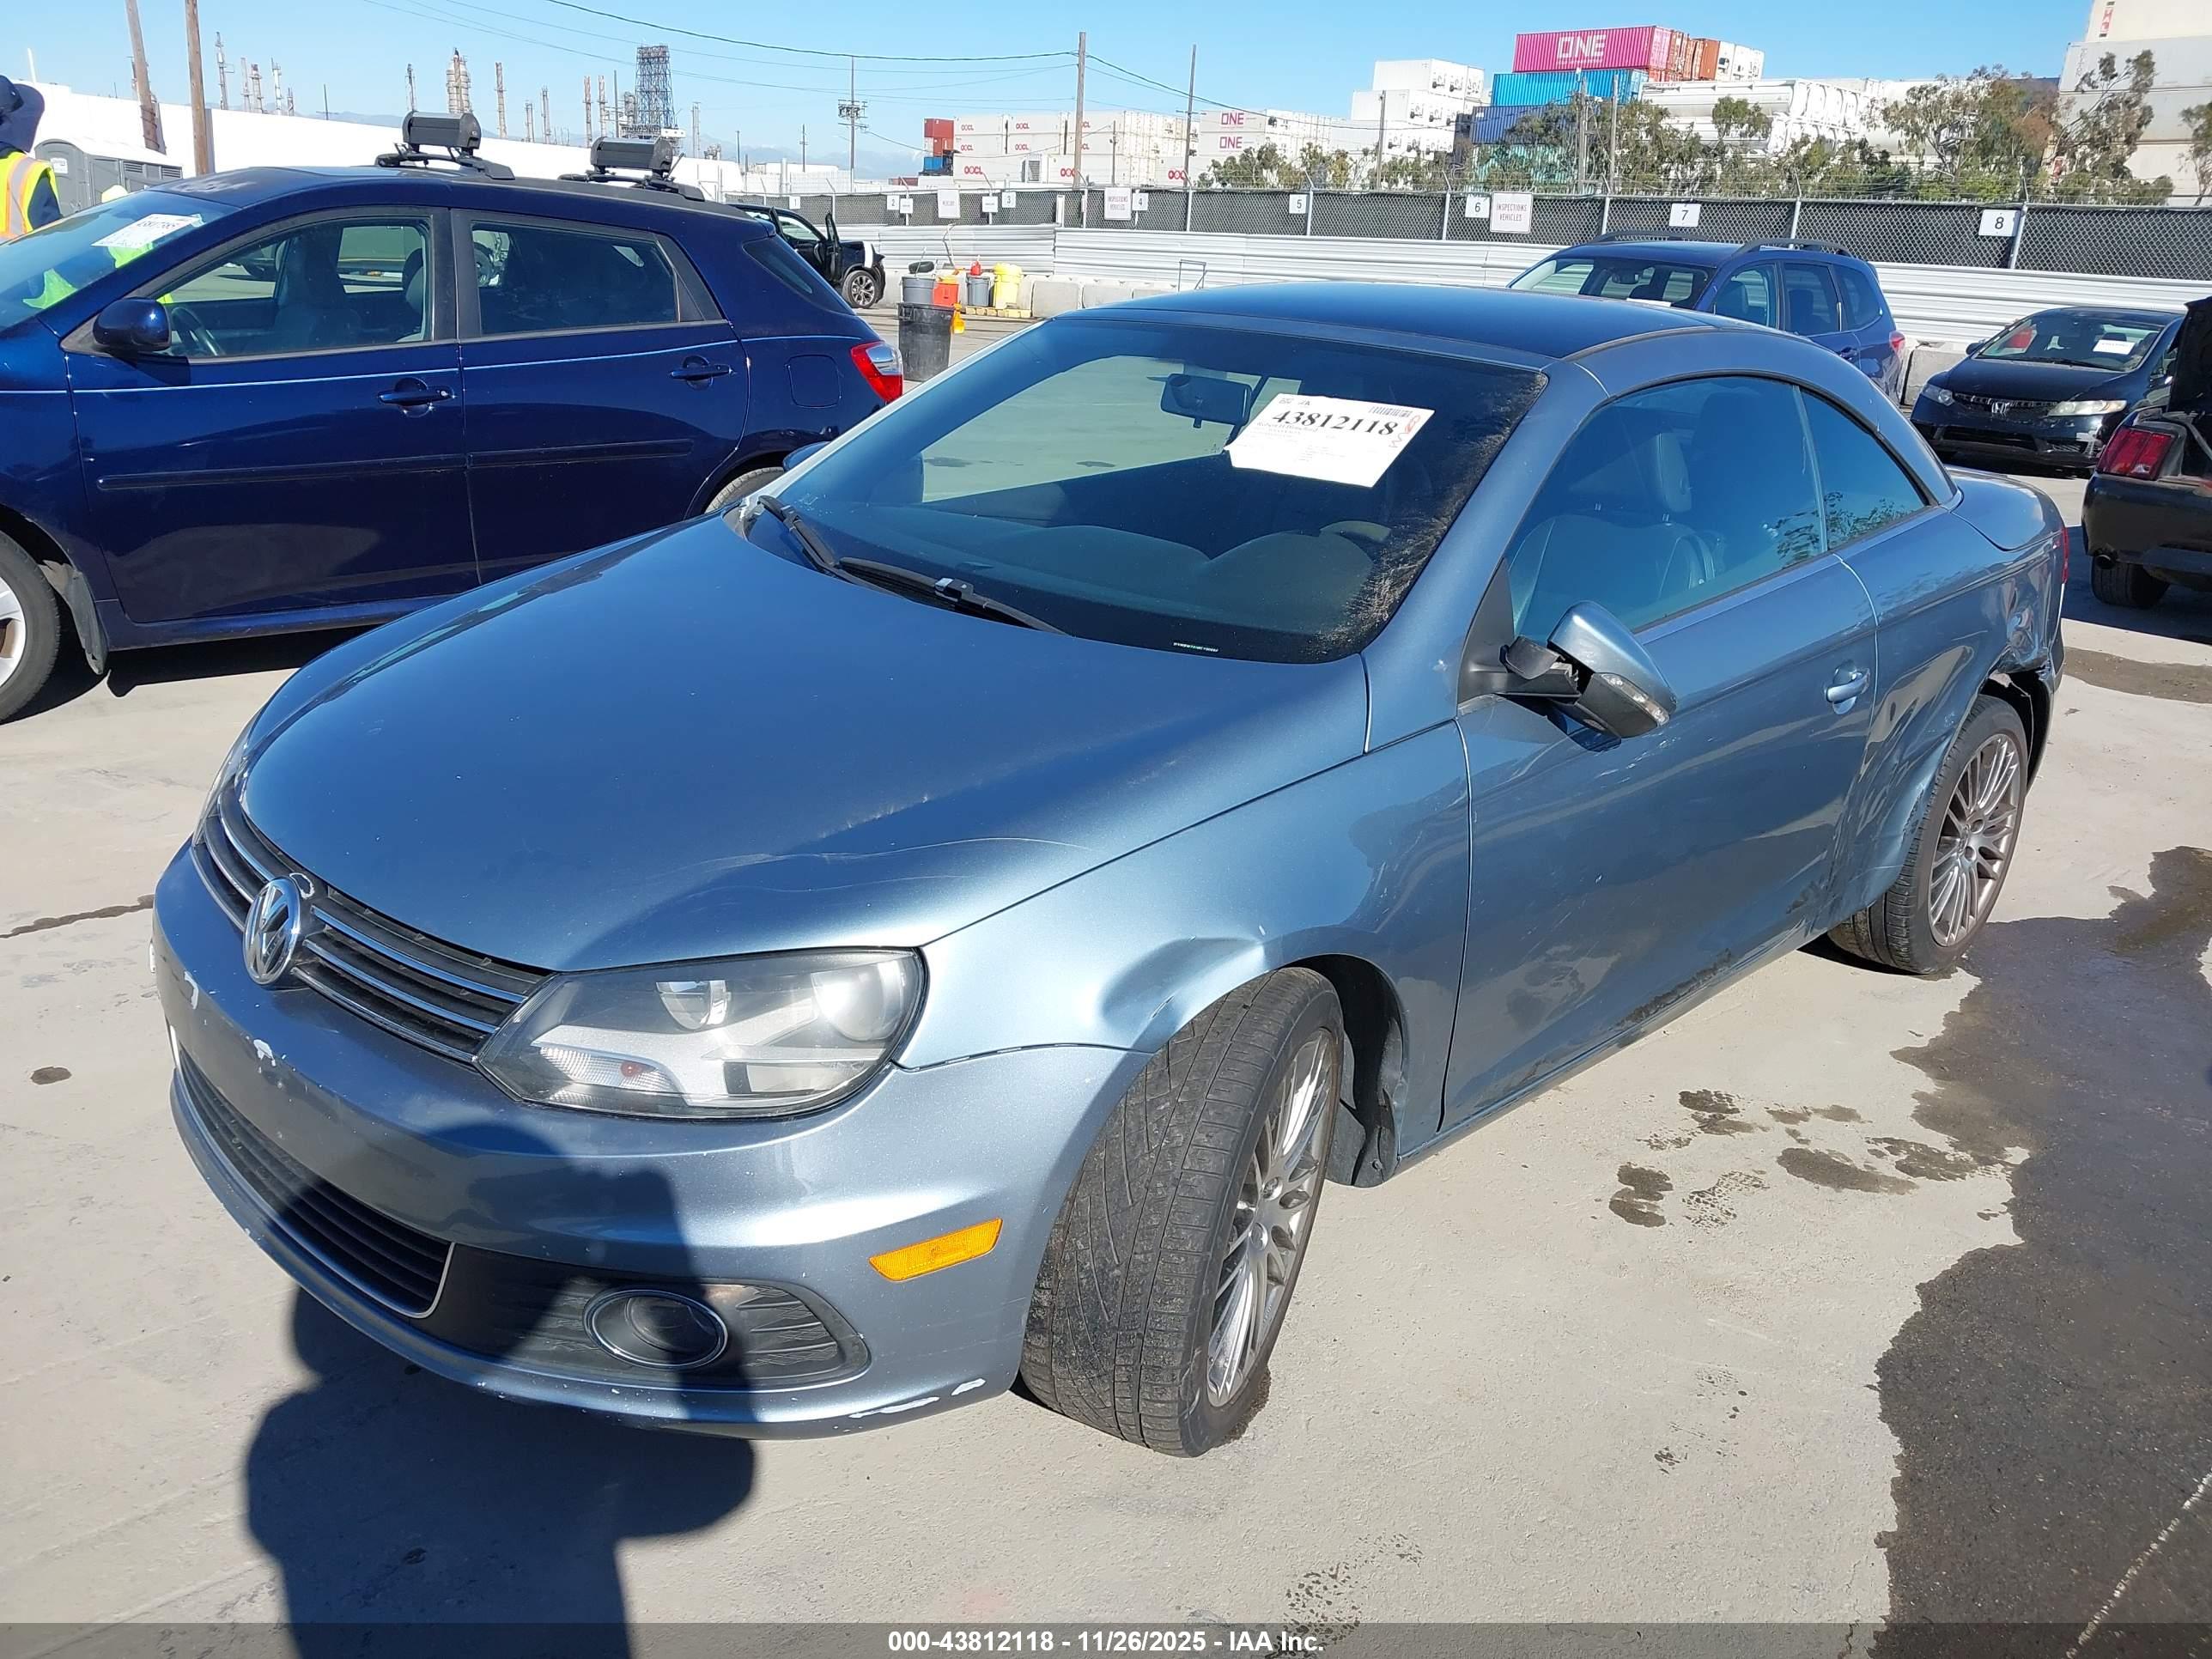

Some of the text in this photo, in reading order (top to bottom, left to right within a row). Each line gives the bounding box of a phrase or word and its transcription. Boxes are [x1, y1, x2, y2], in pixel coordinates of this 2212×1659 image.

[1556, 34, 1607, 59] ONE
[1220, 112, 1244, 125] ONE
[1218, 136, 1243, 149] ONE
[963, 165, 983, 175] OOCL
[1168, 170, 1186, 179] OOC
[1138, 198, 1143, 206] 4
[1297, 198, 1303, 209] 5
[1474, 202, 1481, 213] 6
[1496, 203, 1528, 211] INSPECTIONS
[1499, 213, 1522, 222] VEHICLES
[1681, 210, 1689, 221] 7
[1994, 216, 2005, 230] 8
[1272, 410, 1399, 436] 43812118
